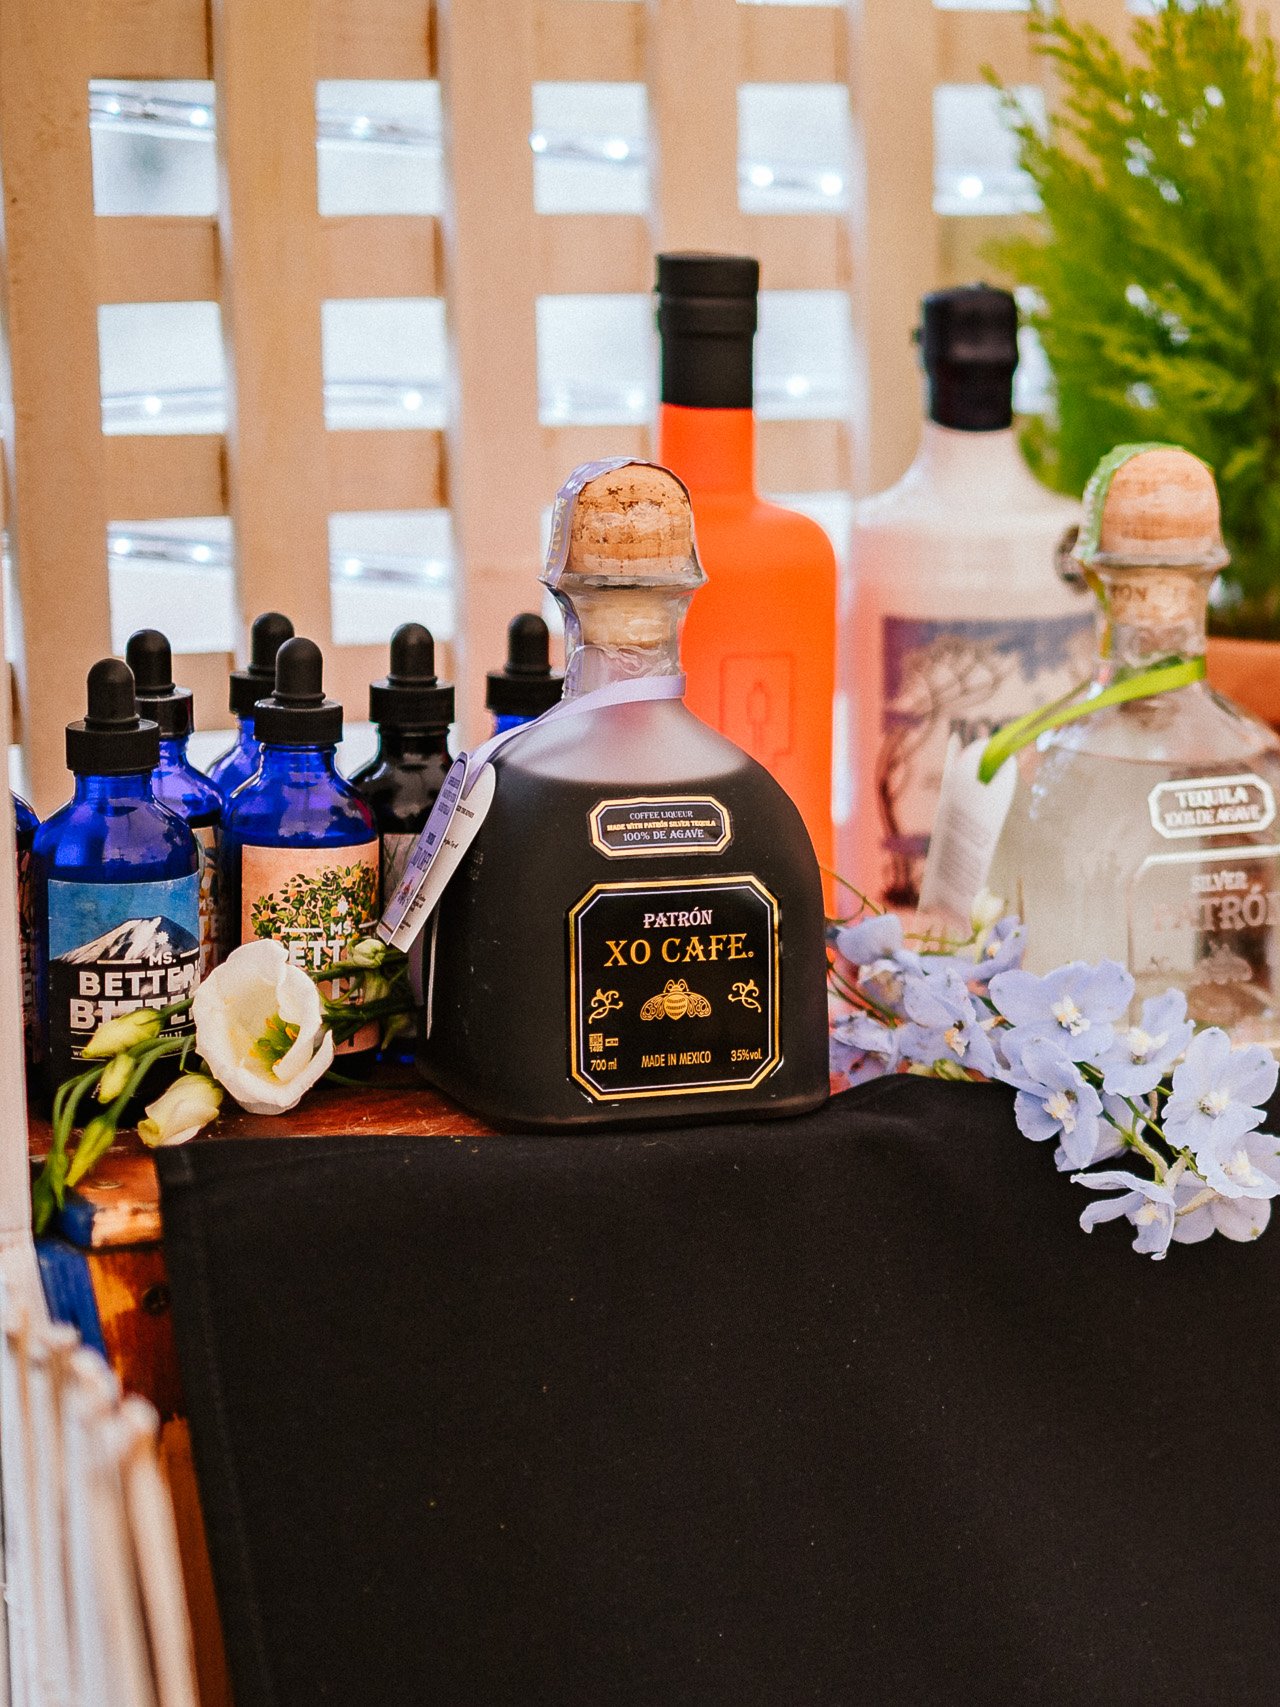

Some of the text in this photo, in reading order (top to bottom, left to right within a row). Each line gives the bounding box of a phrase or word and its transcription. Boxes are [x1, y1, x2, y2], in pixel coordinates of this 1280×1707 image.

[1175, 786, 1249, 808] TEQUILA
[629, 812, 660, 820] COFFEE
[623, 828, 704, 841] 100% DE AGAVE
[643, 907, 713, 928] PATRÓN
[149, 953, 177, 966] MS.
[603, 939, 651, 967] XO
[590, 1058, 617, 1071] 700 ml
[641, 1051, 711, 1068] MADE IN MEXICO
